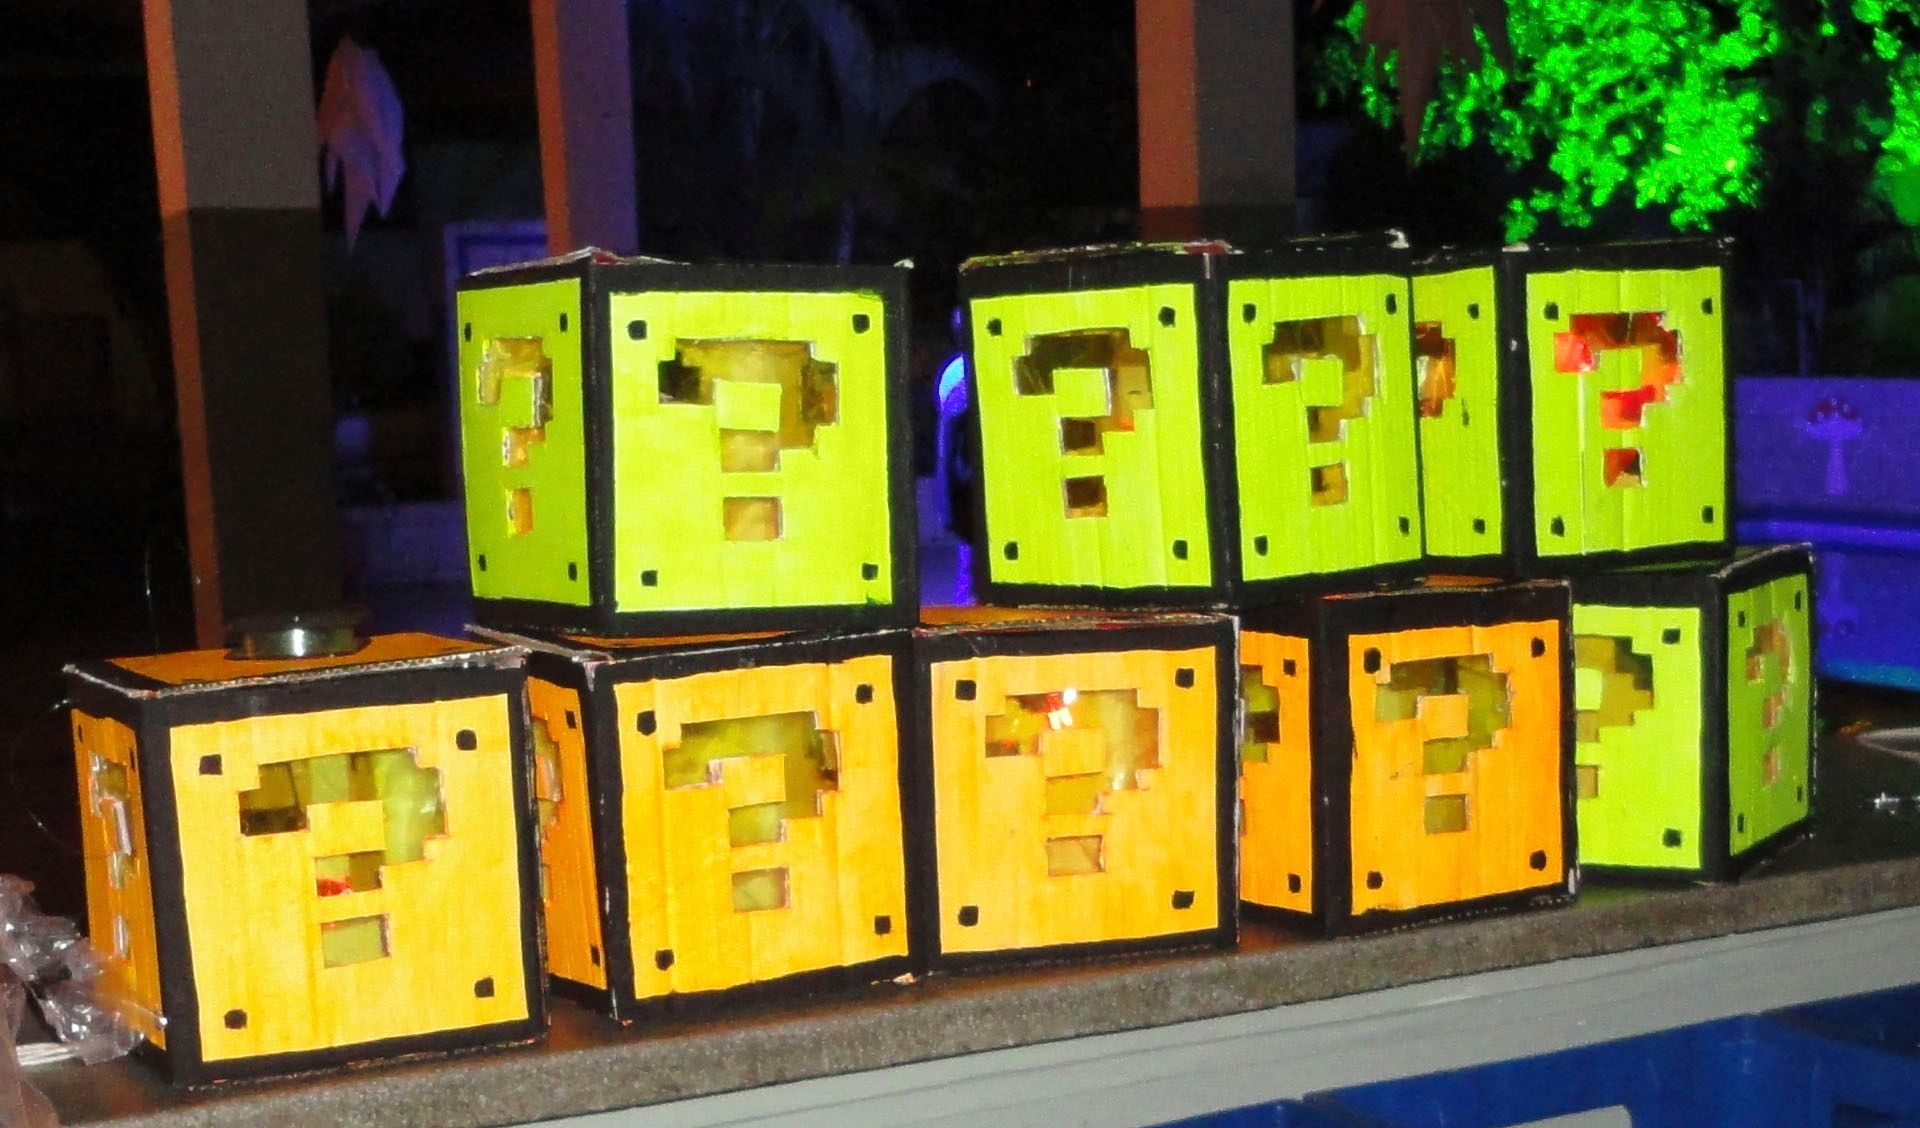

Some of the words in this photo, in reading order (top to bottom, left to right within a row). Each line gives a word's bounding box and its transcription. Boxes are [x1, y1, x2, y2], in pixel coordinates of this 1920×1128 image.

[476, 336, 553, 537] ?
[658, 339, 840, 542] ?
[1011, 327, 1154, 519] ?
[1261, 315, 1382, 506] ?
[1554, 313, 1684, 488] ?
[985, 688, 1164, 877] ?
[1375, 652, 1512, 834] ?
[1745, 618, 1793, 788] ?
[89, 752, 136, 960] ?
[238, 746, 450, 969] ?
[663, 710, 842, 913] ?
